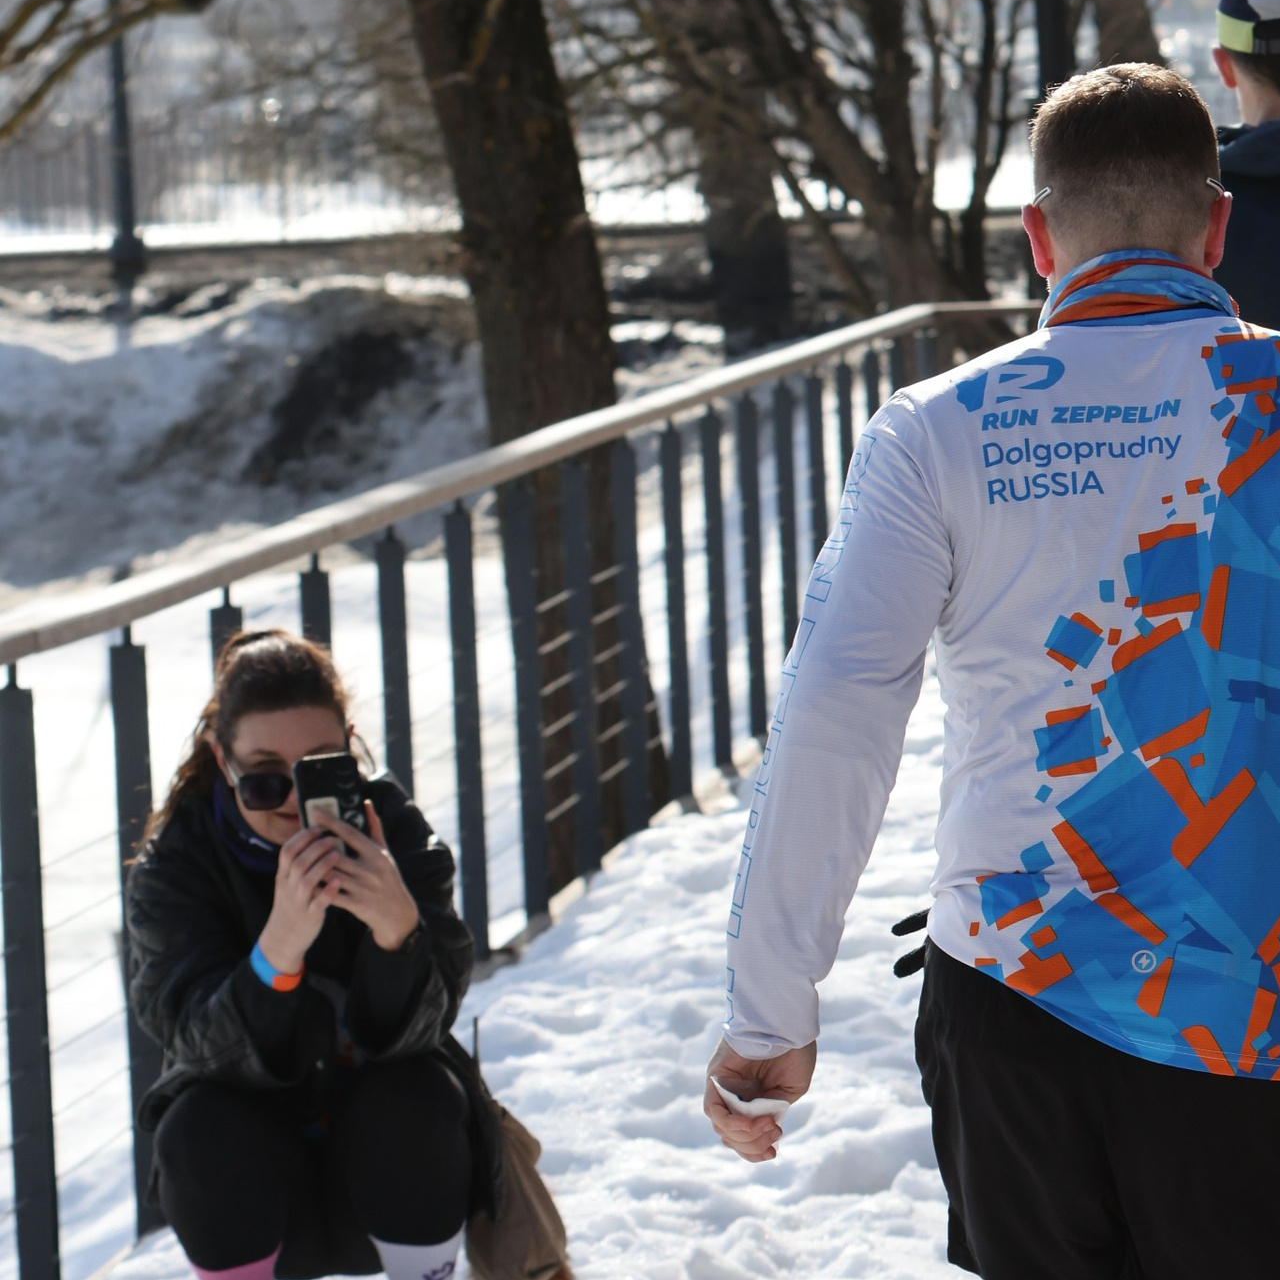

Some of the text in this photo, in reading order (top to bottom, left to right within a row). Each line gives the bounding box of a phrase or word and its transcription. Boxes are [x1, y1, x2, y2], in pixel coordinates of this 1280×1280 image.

[981, 399, 1181, 431] RUN ZEPPELIN
[982, 435, 1182, 468] Dolgoprudny
[987, 471, 1104, 505] RUSSIA
